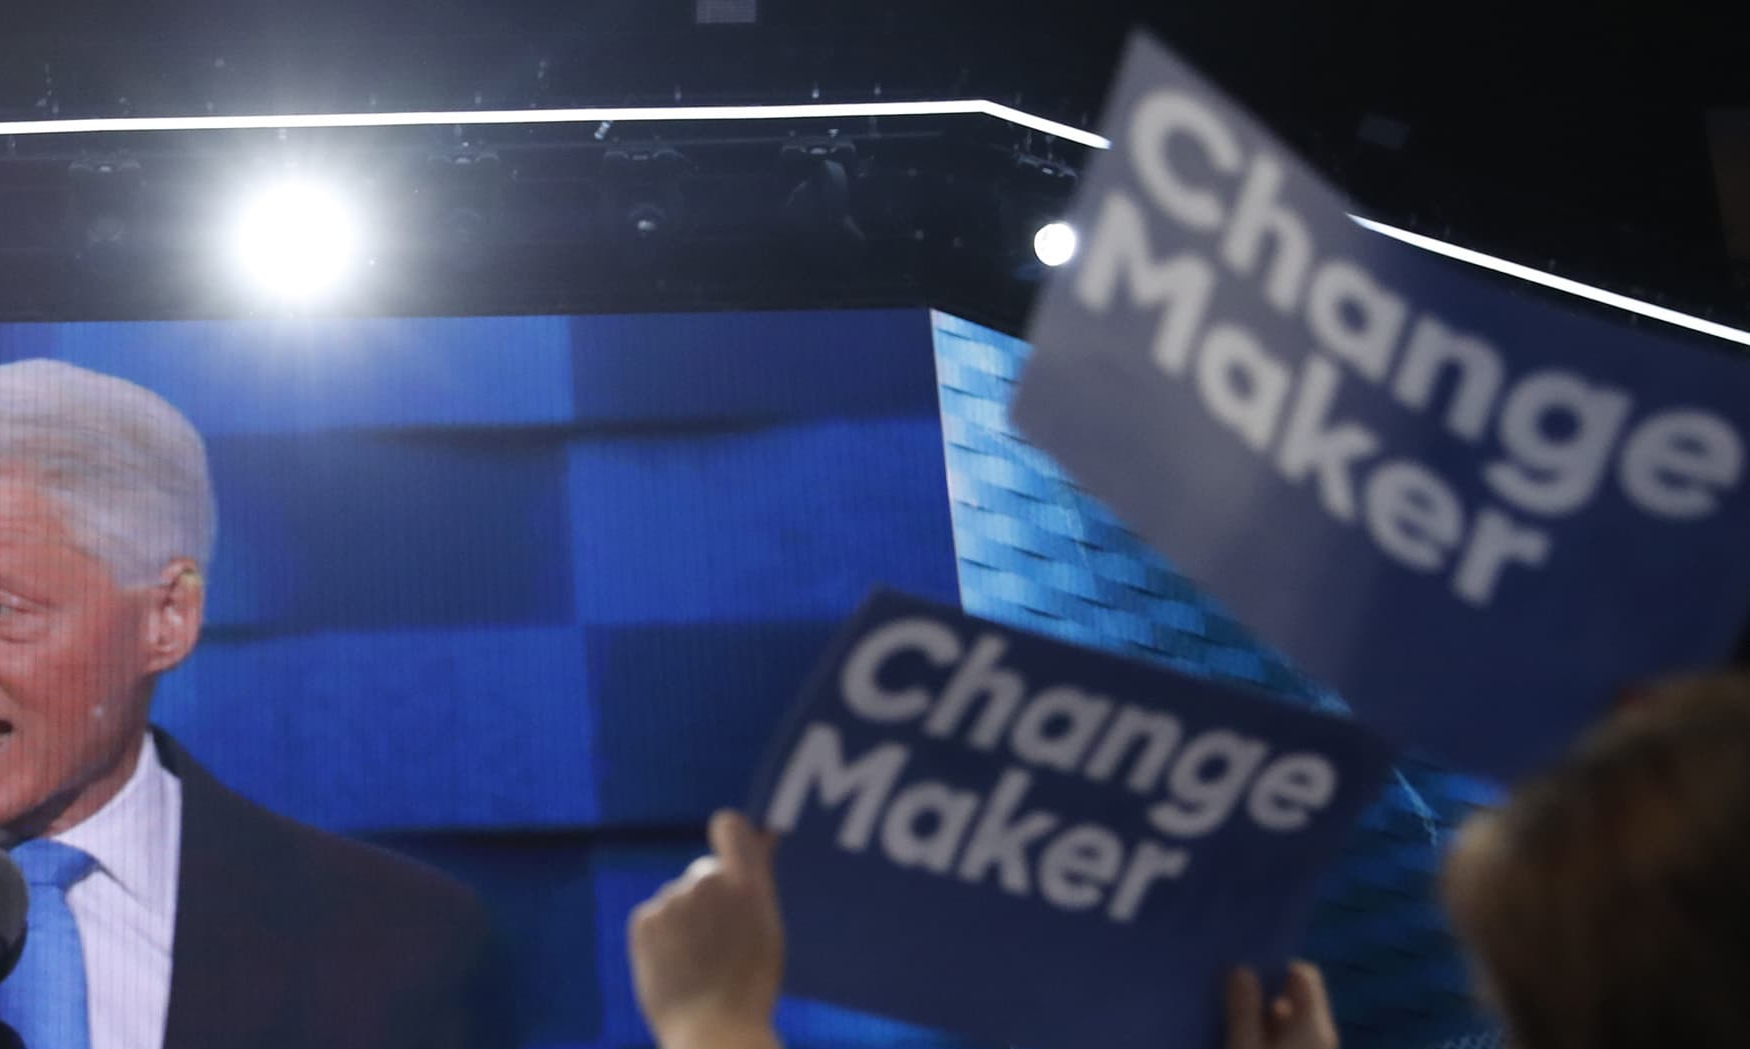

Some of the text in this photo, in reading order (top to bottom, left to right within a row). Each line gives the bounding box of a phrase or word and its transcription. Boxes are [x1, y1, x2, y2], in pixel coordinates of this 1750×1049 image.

[1078, 190, 1554, 609] Maker
[1128, 90, 1743, 520] Change
[766, 722, 1192, 922] Maker
[840, 617, 1340, 838] Change
